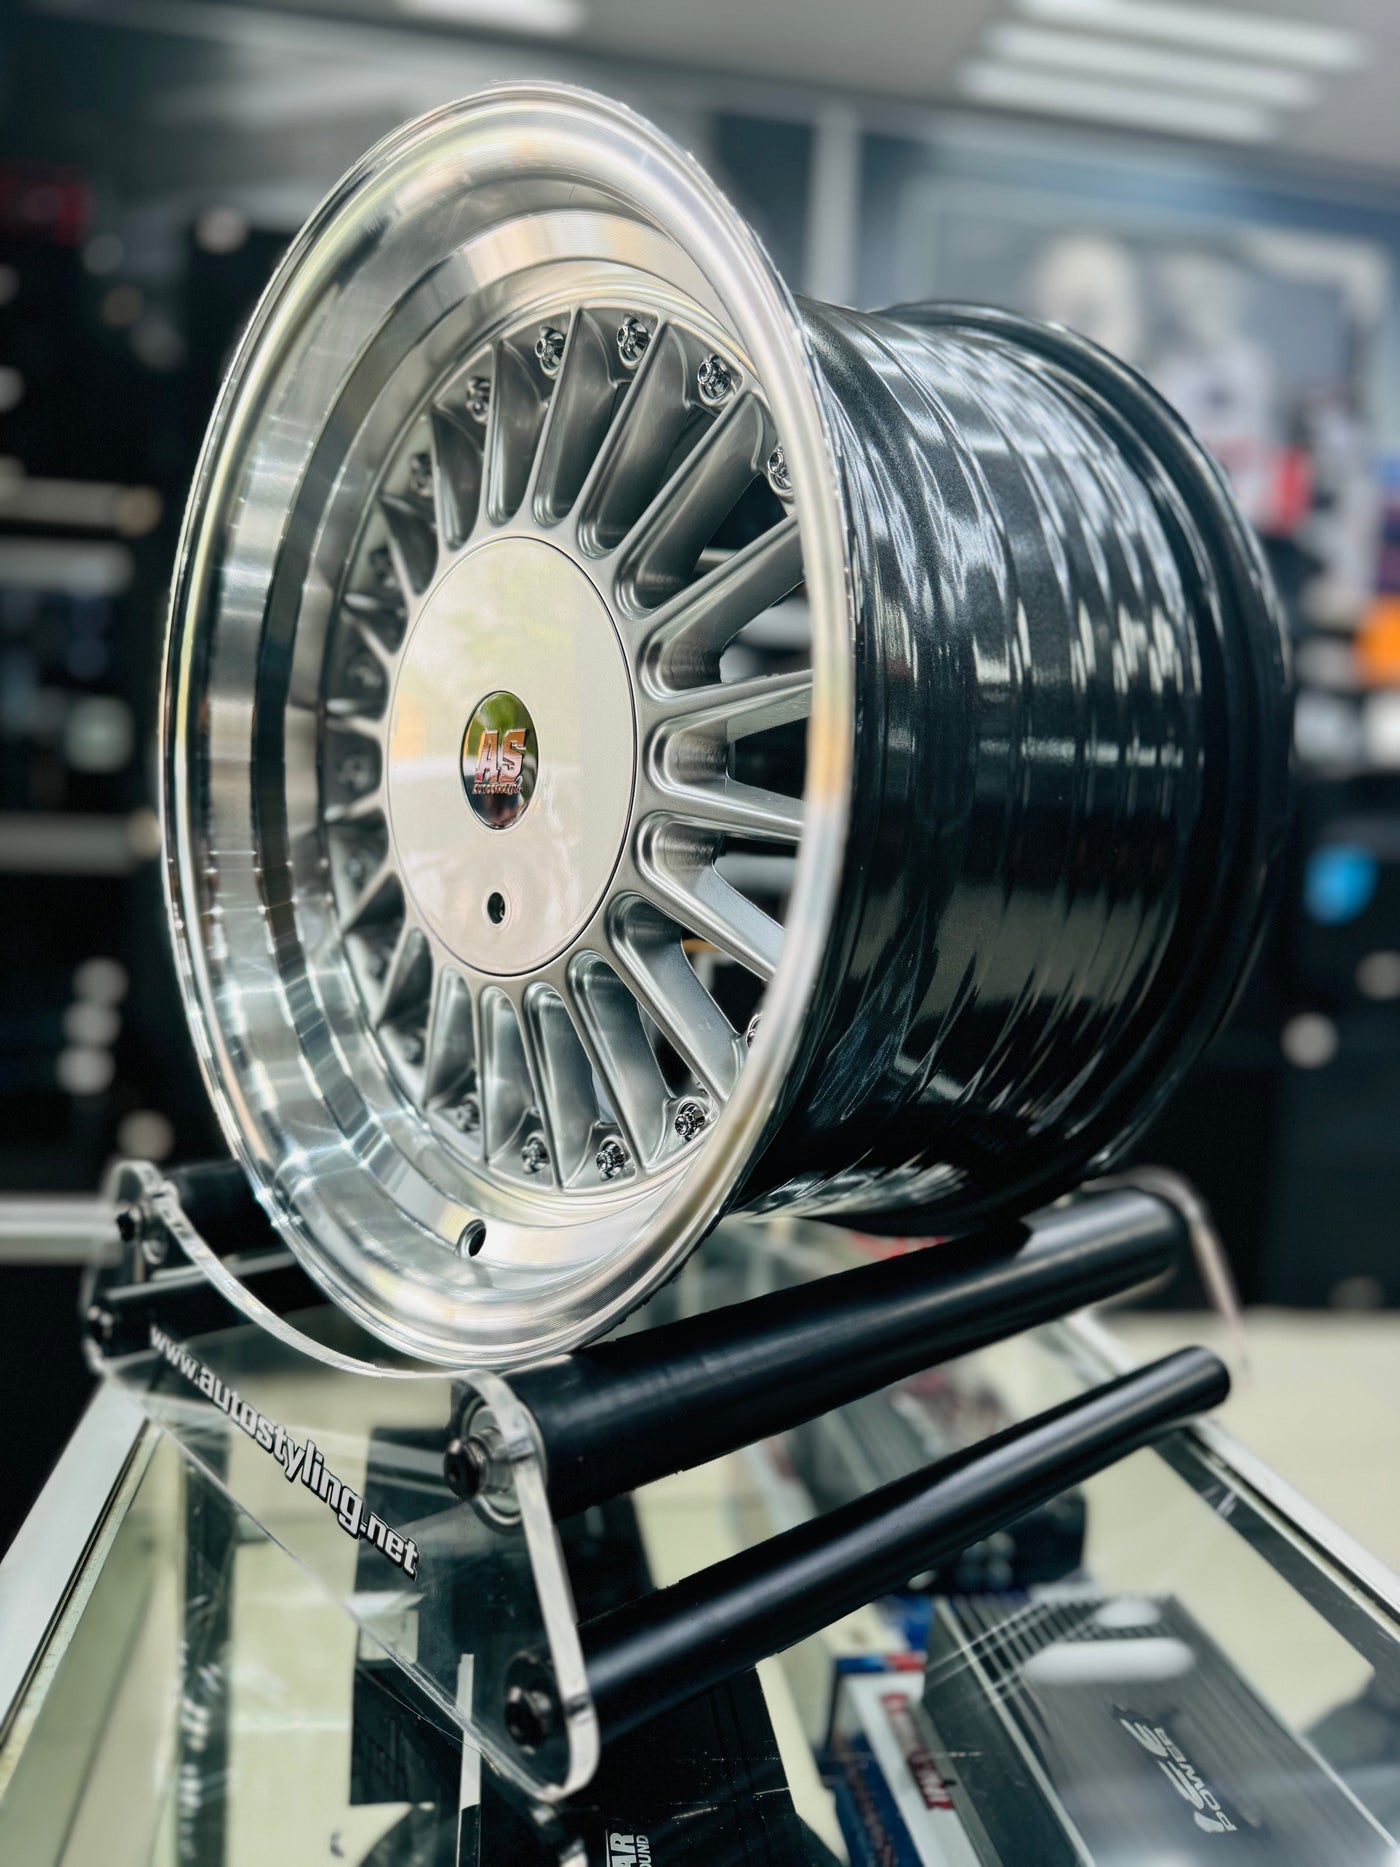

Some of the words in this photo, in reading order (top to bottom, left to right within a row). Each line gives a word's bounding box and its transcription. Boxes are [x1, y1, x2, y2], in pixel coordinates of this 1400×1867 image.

[474, 727, 527, 783] AS
[150, 1323, 420, 1580] www.autostyling.net
[1153, 1727, 1238, 1831] POWER
